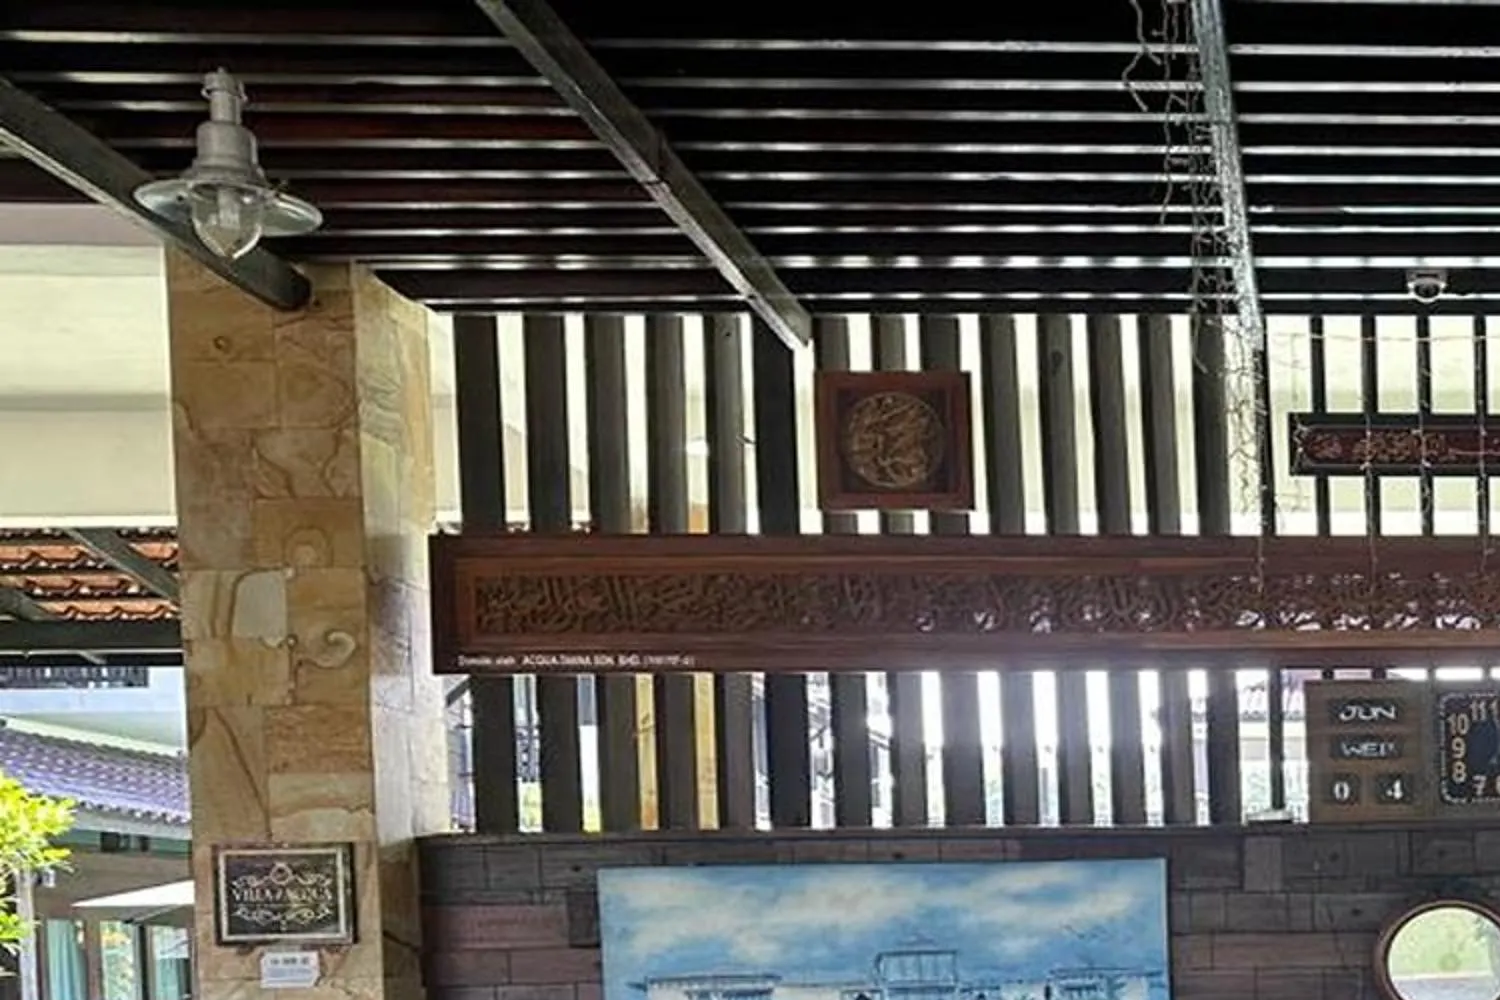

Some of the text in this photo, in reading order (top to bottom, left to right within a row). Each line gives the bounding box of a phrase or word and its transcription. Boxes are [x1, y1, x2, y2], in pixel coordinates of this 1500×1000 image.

[1338, 703, 1397, 721] JUN
[1447, 713, 1469, 736] 10
[1451, 737, 1466, 759] 9
[1452, 761, 1467, 783] 8
[1385, 779, 1404, 800] 4
[1472, 774, 1487, 796] 7
